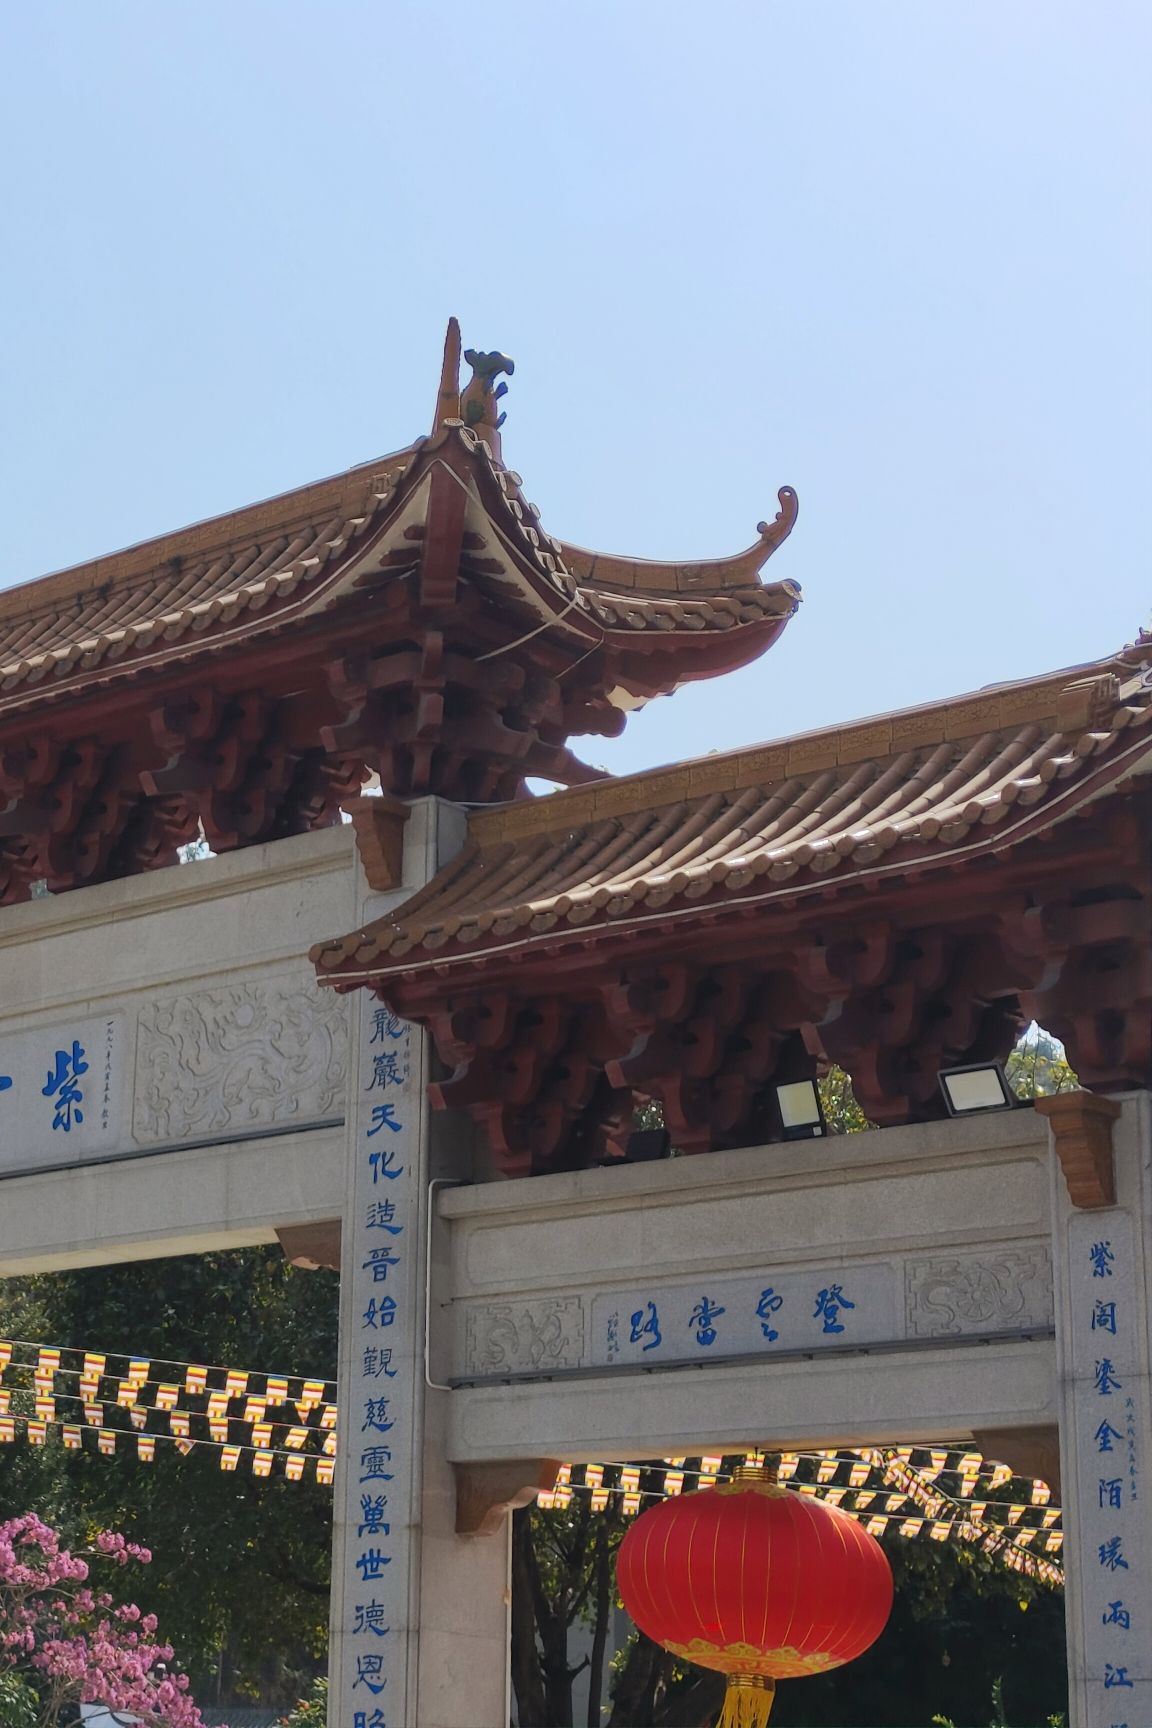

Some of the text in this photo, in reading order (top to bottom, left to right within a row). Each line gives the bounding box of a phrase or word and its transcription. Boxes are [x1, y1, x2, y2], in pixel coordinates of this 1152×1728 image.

[1089, 1241, 1135, 1728] 紫閣鎏金陌環兩江
